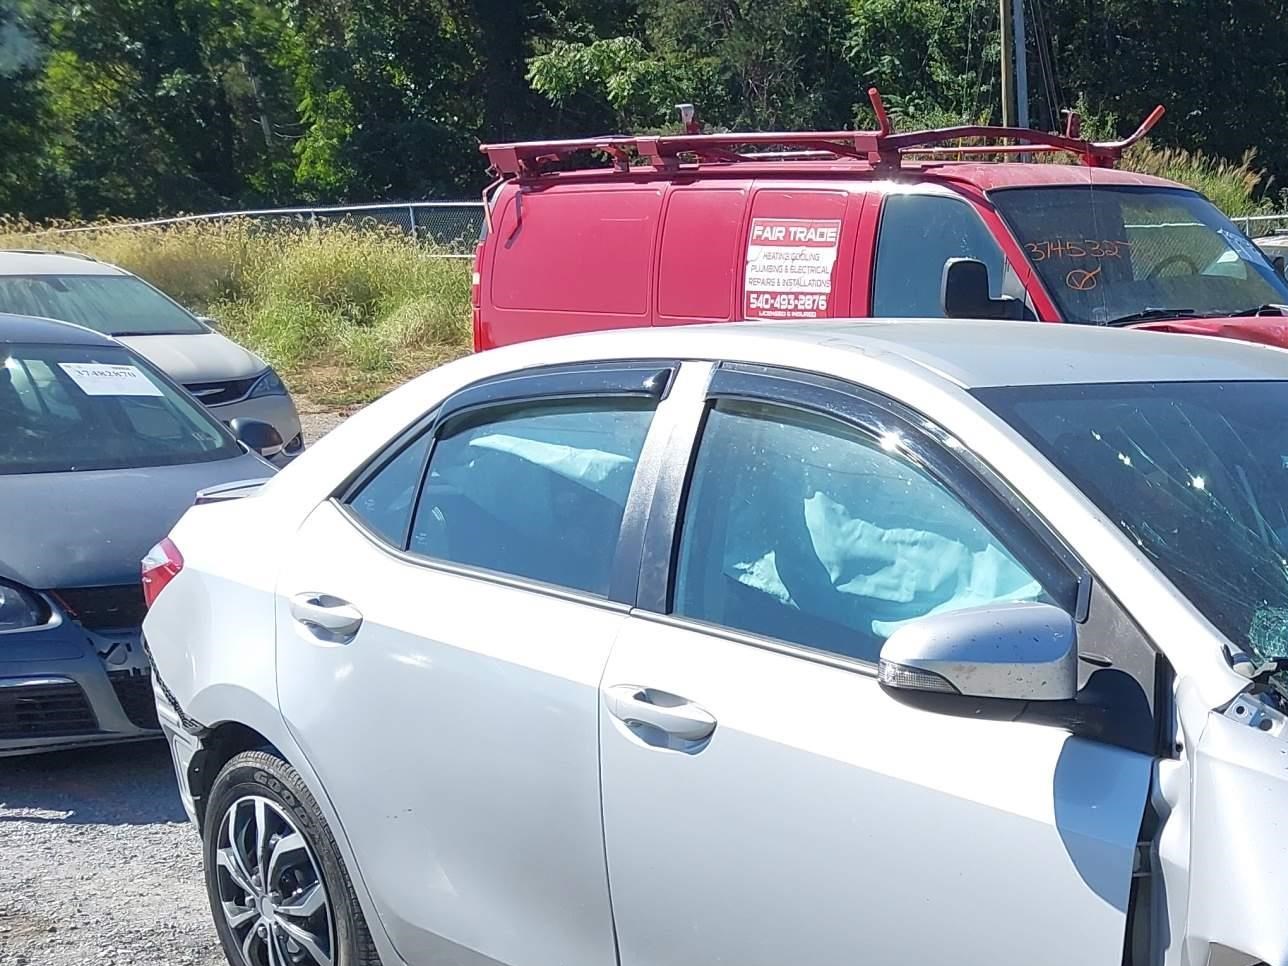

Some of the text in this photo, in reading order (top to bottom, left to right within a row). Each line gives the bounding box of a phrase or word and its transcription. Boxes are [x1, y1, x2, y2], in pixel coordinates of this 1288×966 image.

[752, 225, 838, 242] FAIR TRADE
[751, 265, 783, 274] PLUMBING
[790, 265, 829, 275] ELECTRICAL
[749, 278, 776, 287] REPAIRS
[782, 279, 831, 288] INSTALLATIONS
[749, 294, 827, 311] 540-493-2876
